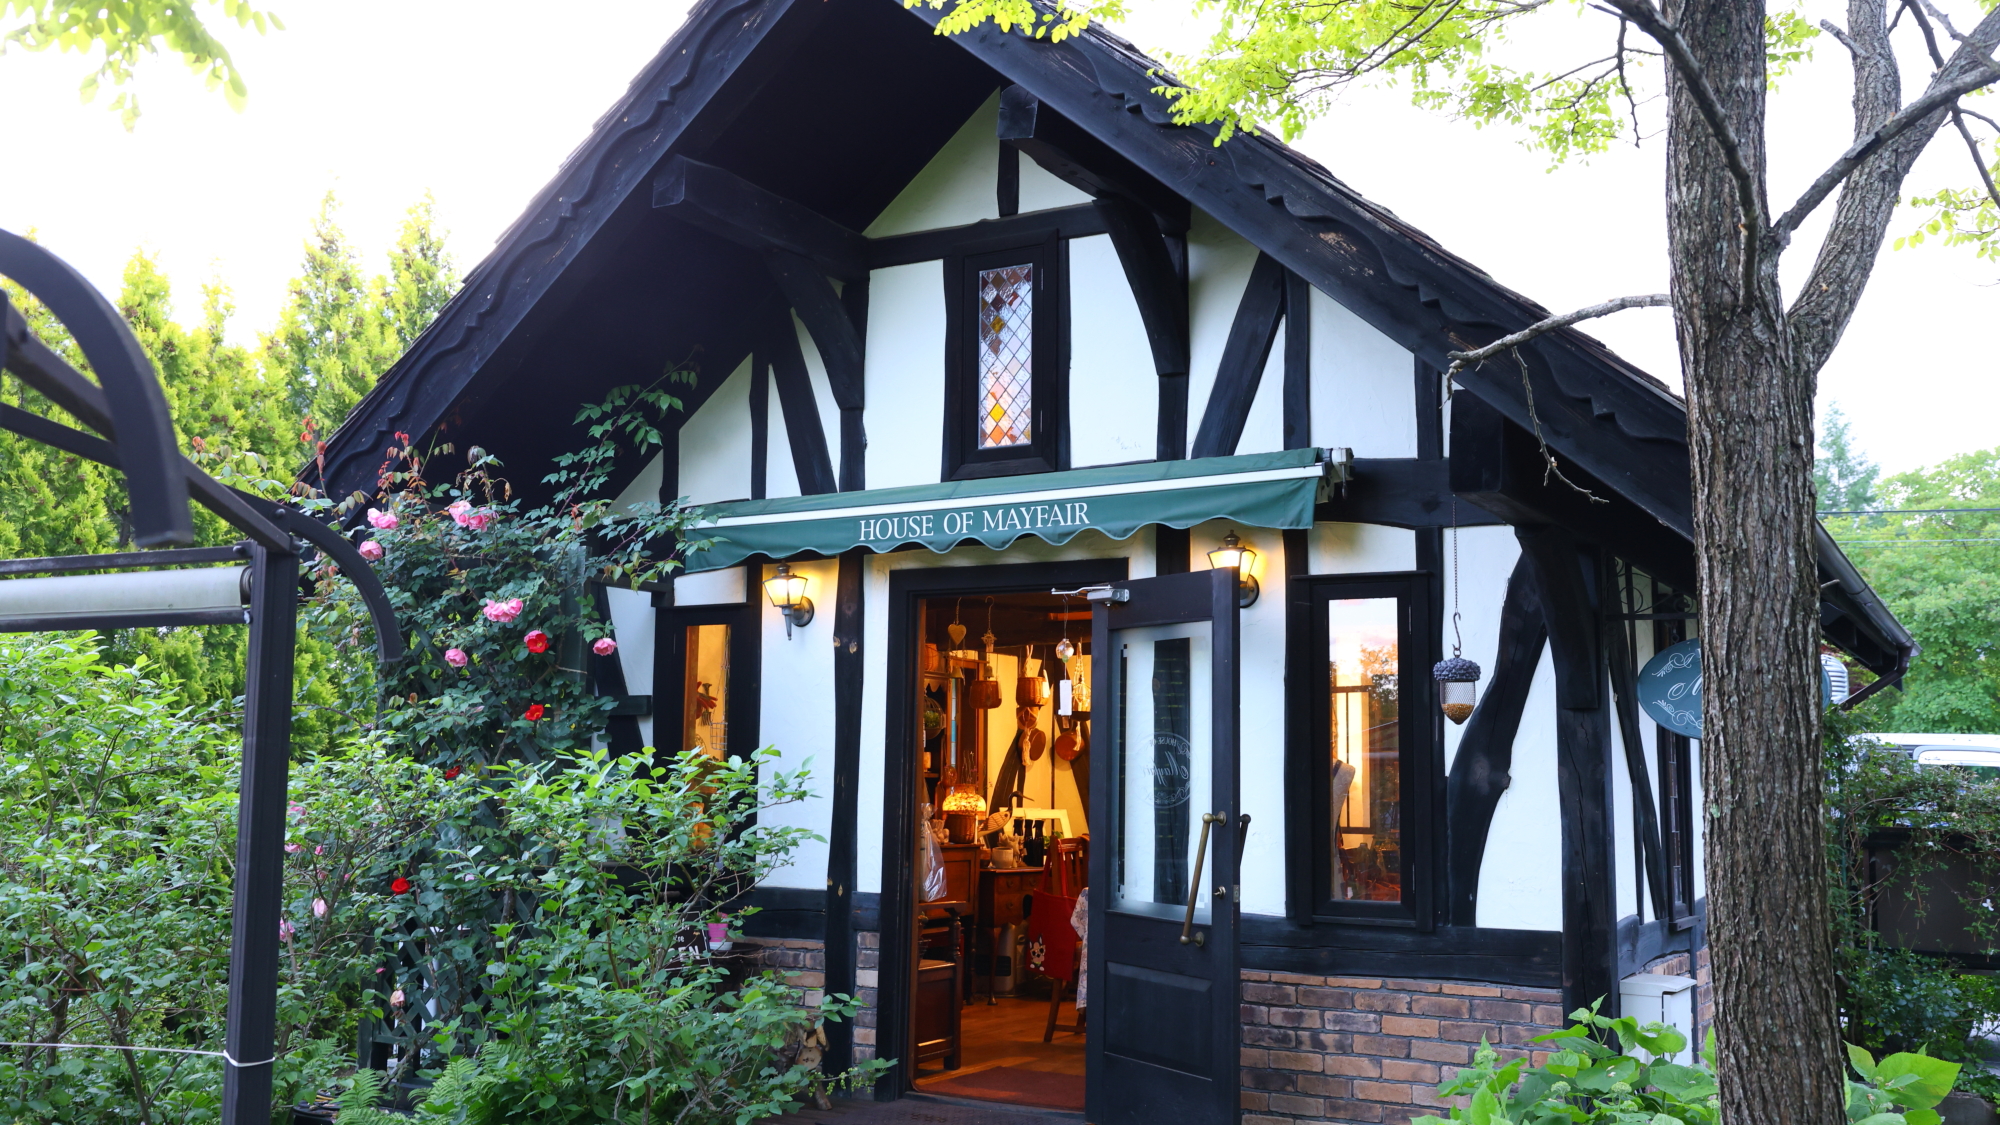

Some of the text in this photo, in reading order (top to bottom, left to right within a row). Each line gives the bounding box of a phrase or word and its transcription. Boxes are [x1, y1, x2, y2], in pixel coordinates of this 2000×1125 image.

[859, 502, 1091, 541] HOUSE OF MAYFAIR
